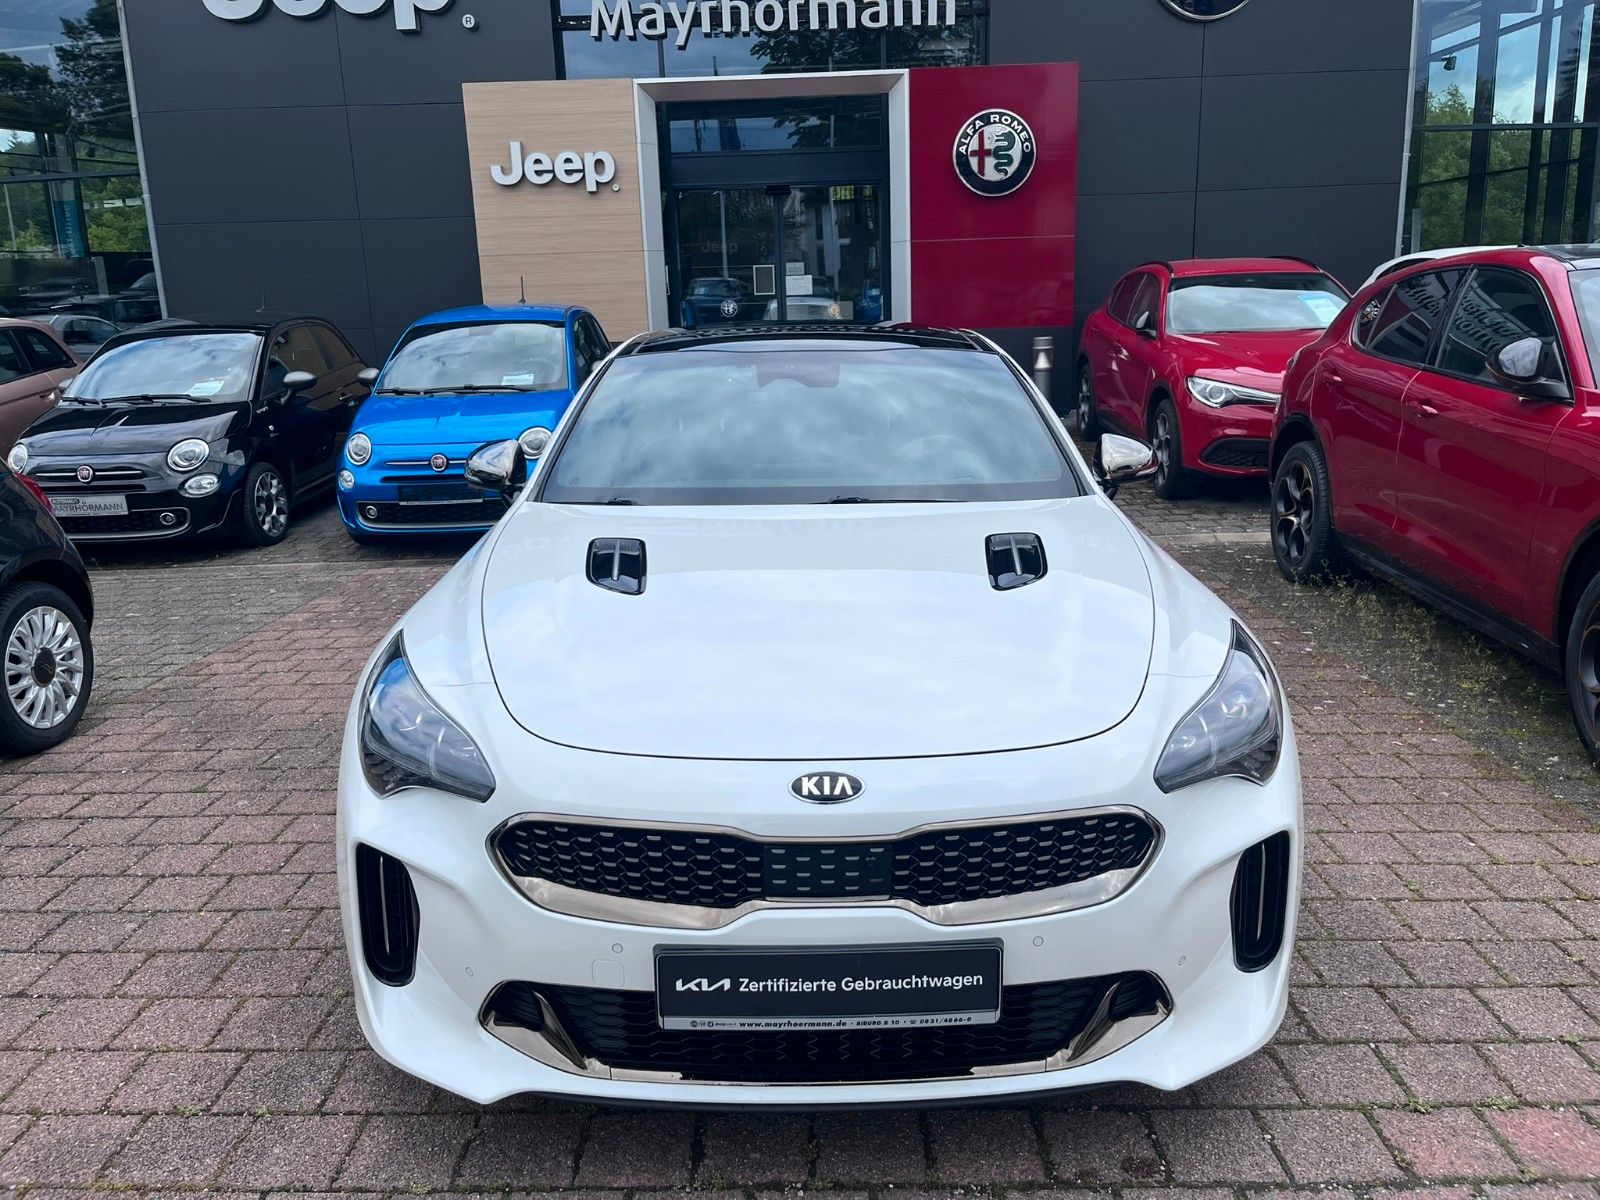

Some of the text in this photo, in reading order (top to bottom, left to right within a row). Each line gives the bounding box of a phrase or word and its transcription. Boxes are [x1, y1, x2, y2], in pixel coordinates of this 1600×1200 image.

[959, 114, 1031, 155] ALFA ROMEO
[490, 141, 616, 193] Jeep
[801, 776, 854, 796] KIA
[739, 978, 836, 992] Zertifizierte
[841, 975, 983, 991] Gebrauchtwagen
[739, 1019, 847, 1028] www.mayrhoermann.de
